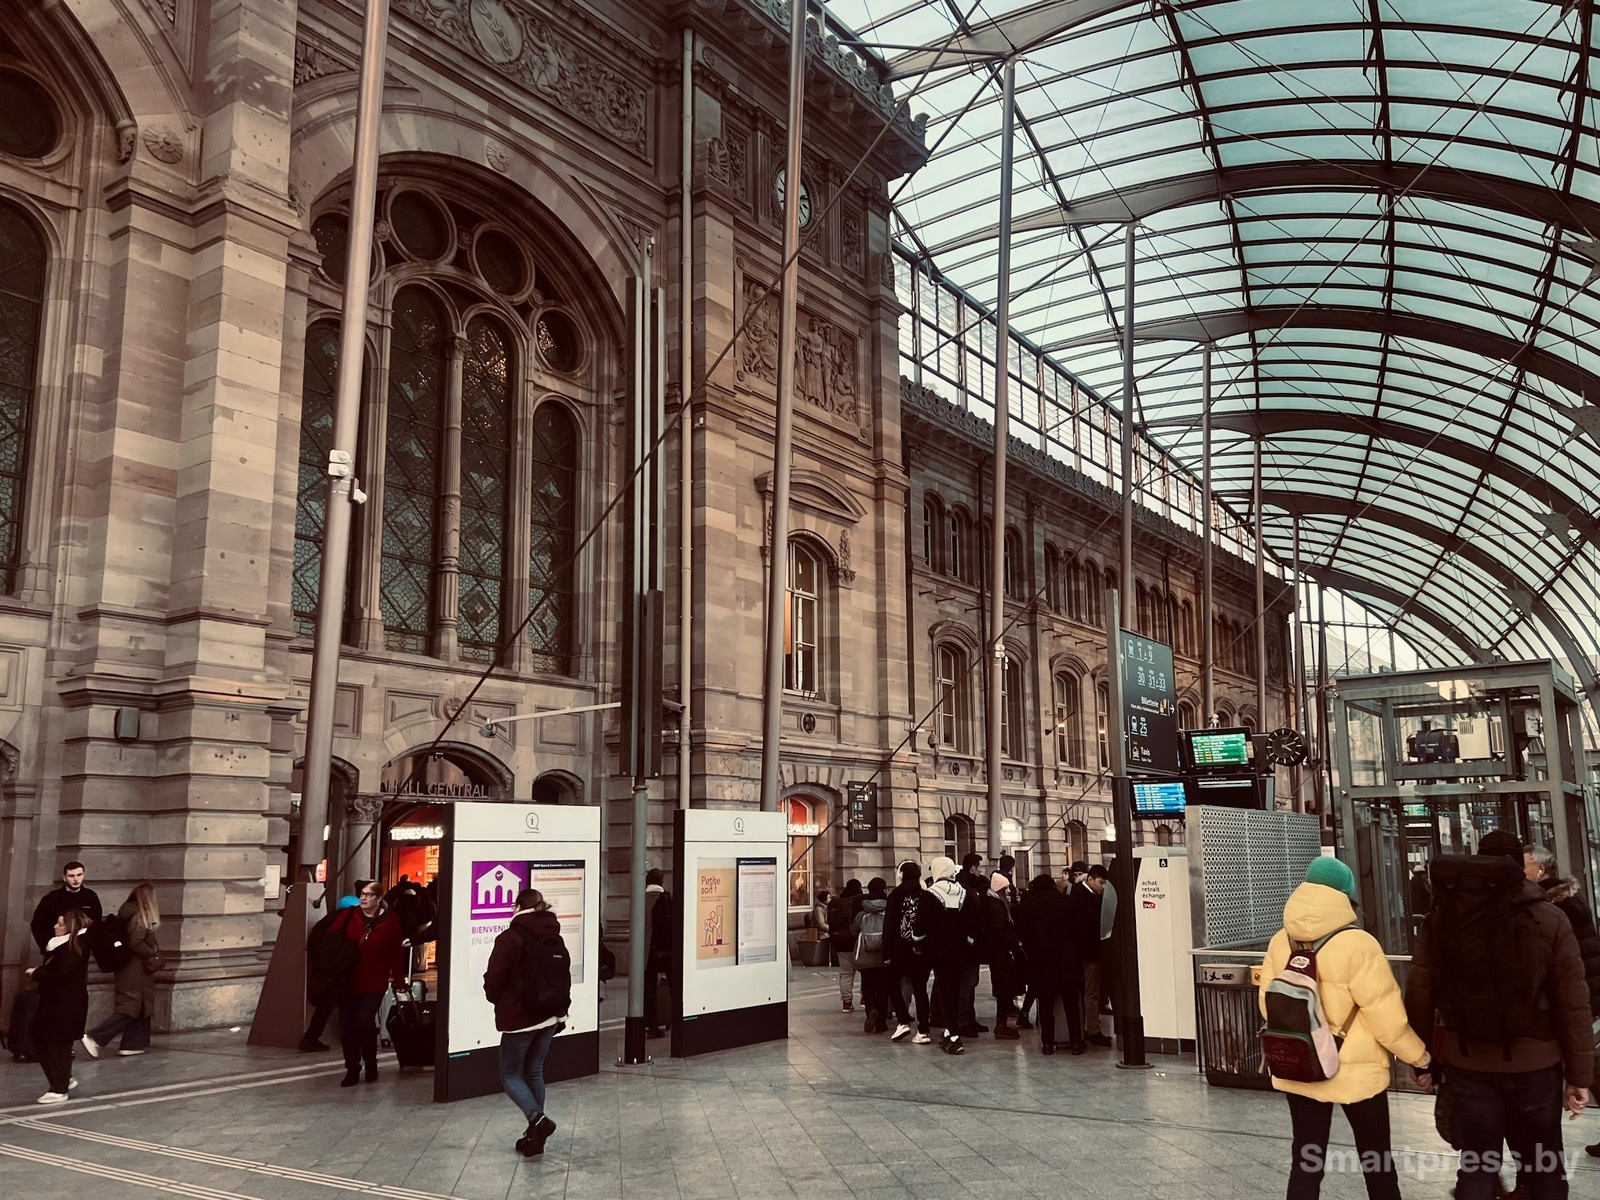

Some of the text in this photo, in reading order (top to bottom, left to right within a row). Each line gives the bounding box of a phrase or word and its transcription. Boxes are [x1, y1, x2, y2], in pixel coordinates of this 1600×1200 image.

[1137, 671, 1146, 684] 30
[1148, 674, 1156, 687] 31
[1158, 677, 1166, 690] 33
[1140, 722, 1148, 735] 25
[428, 782, 488, 798] CENTRAL
[701, 876, 721, 885] Petite
